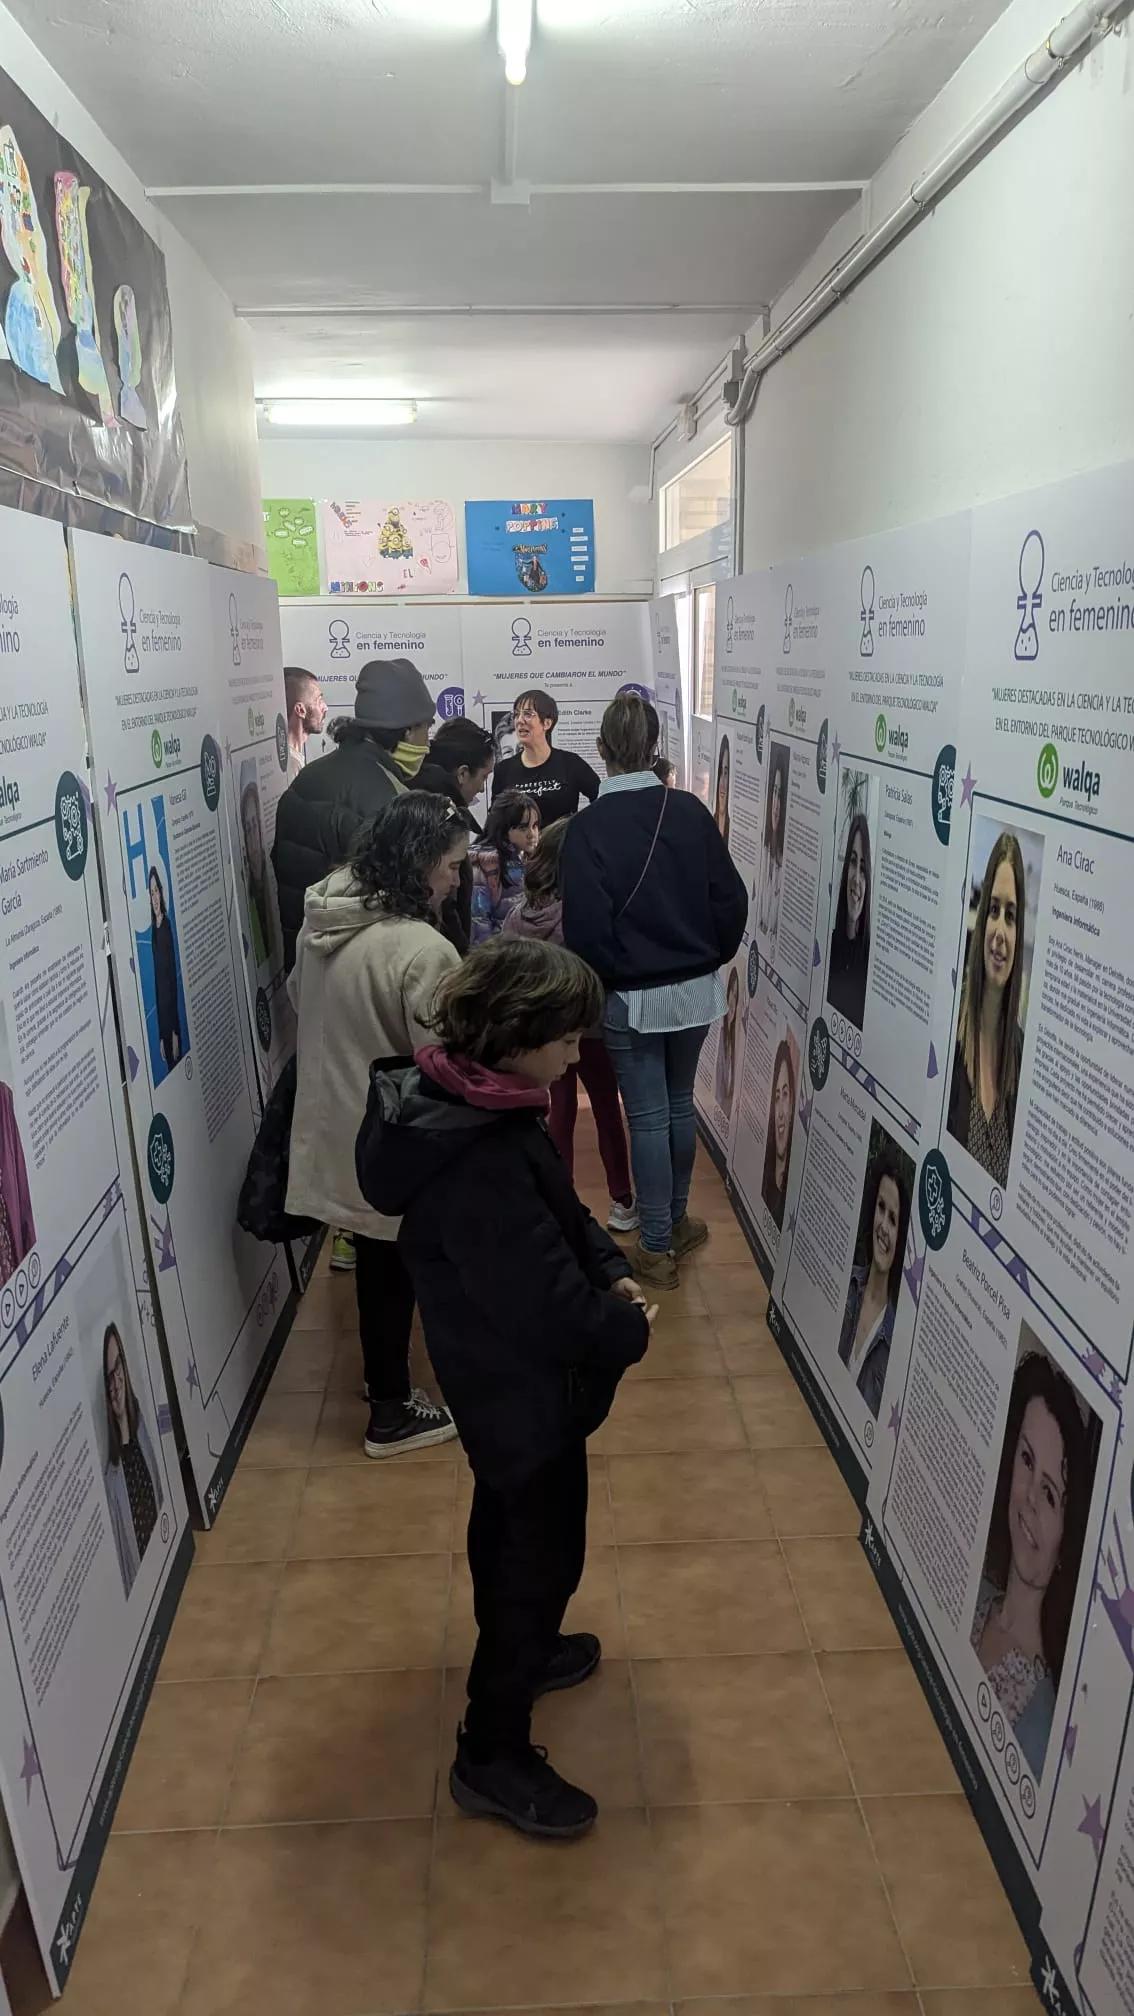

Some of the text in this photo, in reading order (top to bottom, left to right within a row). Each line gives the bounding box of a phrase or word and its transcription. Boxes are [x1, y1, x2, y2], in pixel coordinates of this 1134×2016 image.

[1052, 560, 1134, 596] Ciencia y Tecnolo
[878, 595, 895, 611] Ciencia
[900, 590, 927, 610] Tecnología
[878, 614, 926, 637] en femenino
[1048, 610, 1066, 632] en
[151, 630, 182, 651] femenino
[356, 632, 382, 640] Ciencia
[390, 631, 426, 641] Tecnología
[356, 639, 424, 650] en femenino
[538, 638, 604, 648] en femenino
[570, 628, 607, 638] Tecnología
[1018, 689, 1056, 706] DESTACADAS
[1056, 691, 1066, 708] EN
[1067, 692, 1076, 708] LA
[1076, 693, 1104, 711] CIENCIA
[1112, 696, 1121, 712] LA
[164, 732, 180, 759] walqa
[889, 724, 908, 752] walqa
[995, 717, 1003, 730] EN
[1003, 718, 1009, 732] EL
[1010, 719, 1038, 736] ENTORNO
[1039, 723, 1050, 738] DEL
[1052, 725, 1076, 742] PARQUE
[1077, 728, 1128, 751] TECNOLÓGICO
[1063, 760, 1100, 802] walqa
[1057, 844, 1095, 875] Ana Cirac
[1, 890, 22, 916] García
[962, 1248, 980, 1282] Beatriz
[980, 1272, 999, 1304] Porcel
[998, 1294, 1010, 1320] Pisa
